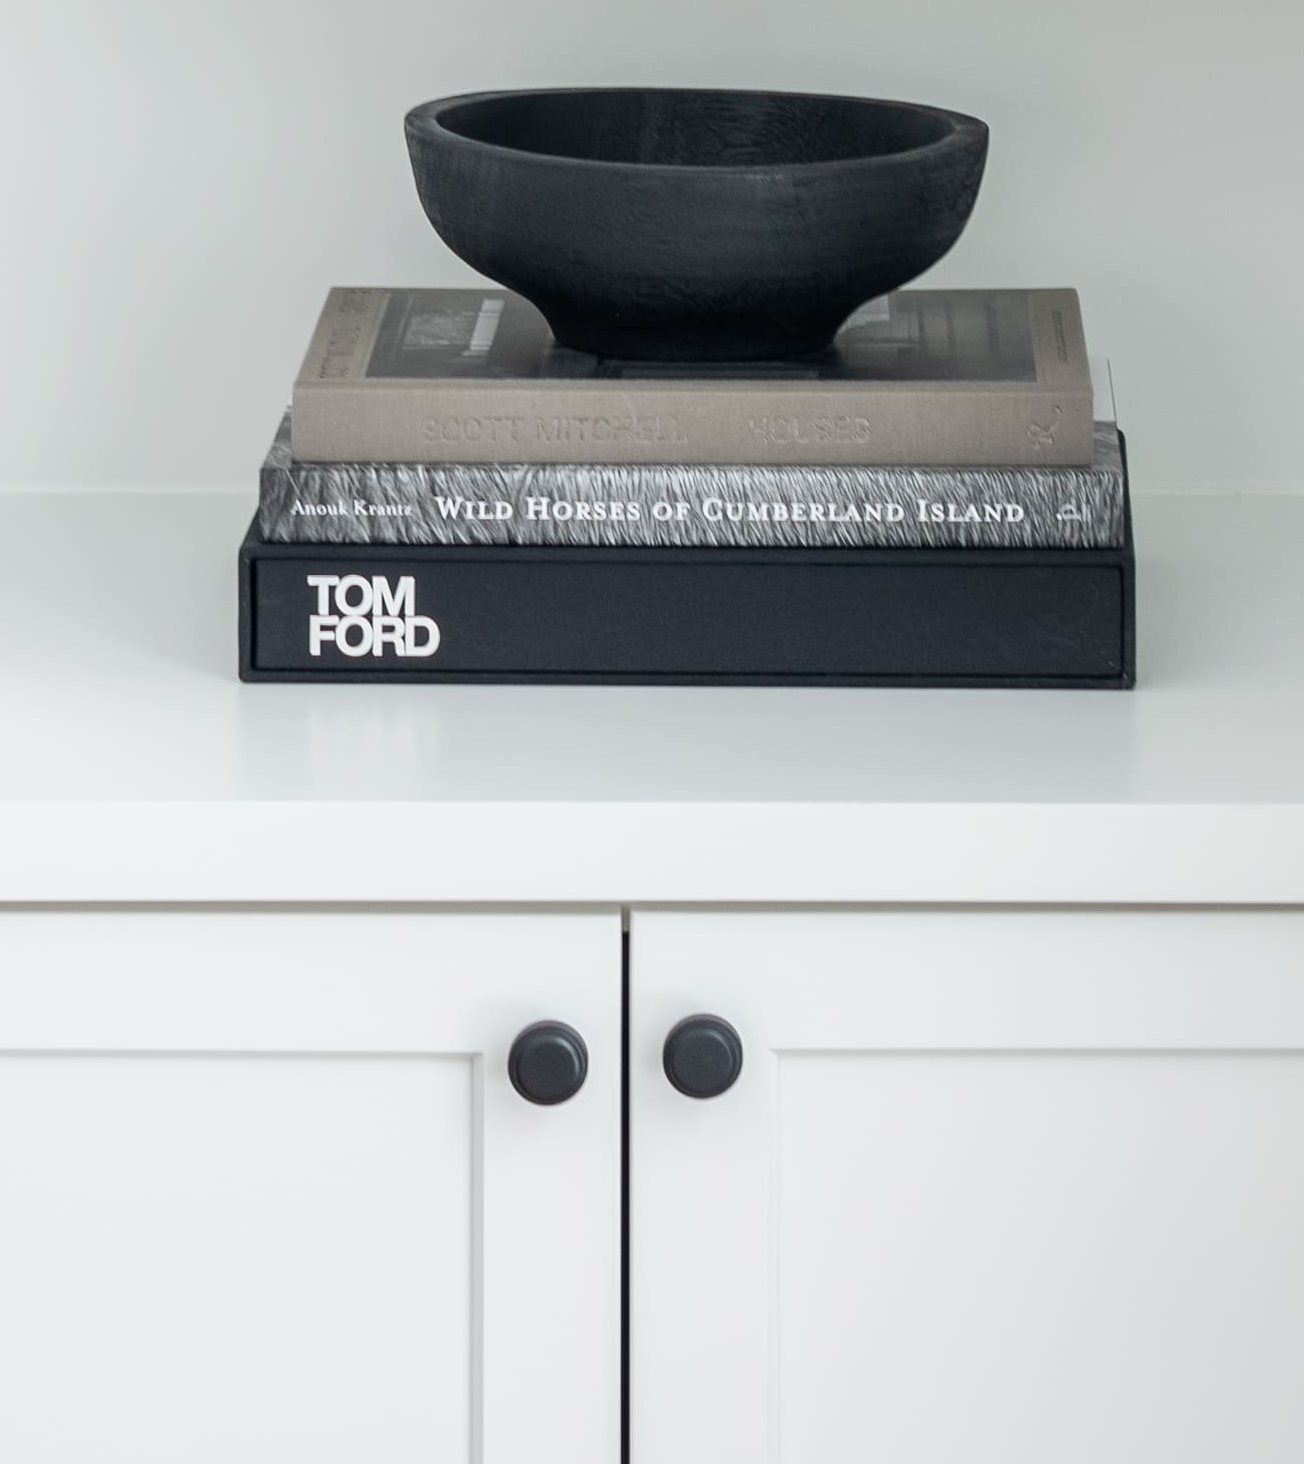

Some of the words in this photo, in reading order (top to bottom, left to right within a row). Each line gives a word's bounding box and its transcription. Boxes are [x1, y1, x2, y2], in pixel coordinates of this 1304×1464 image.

[423, 415, 526, 445] SCOTT
[536, 415, 689, 445] MITCHELL
[290, 499, 348, 517] Anouk
[353, 499, 414, 517] Krantz
[306, 574, 415, 617] TOM
[309, 615, 441, 657] FORD
